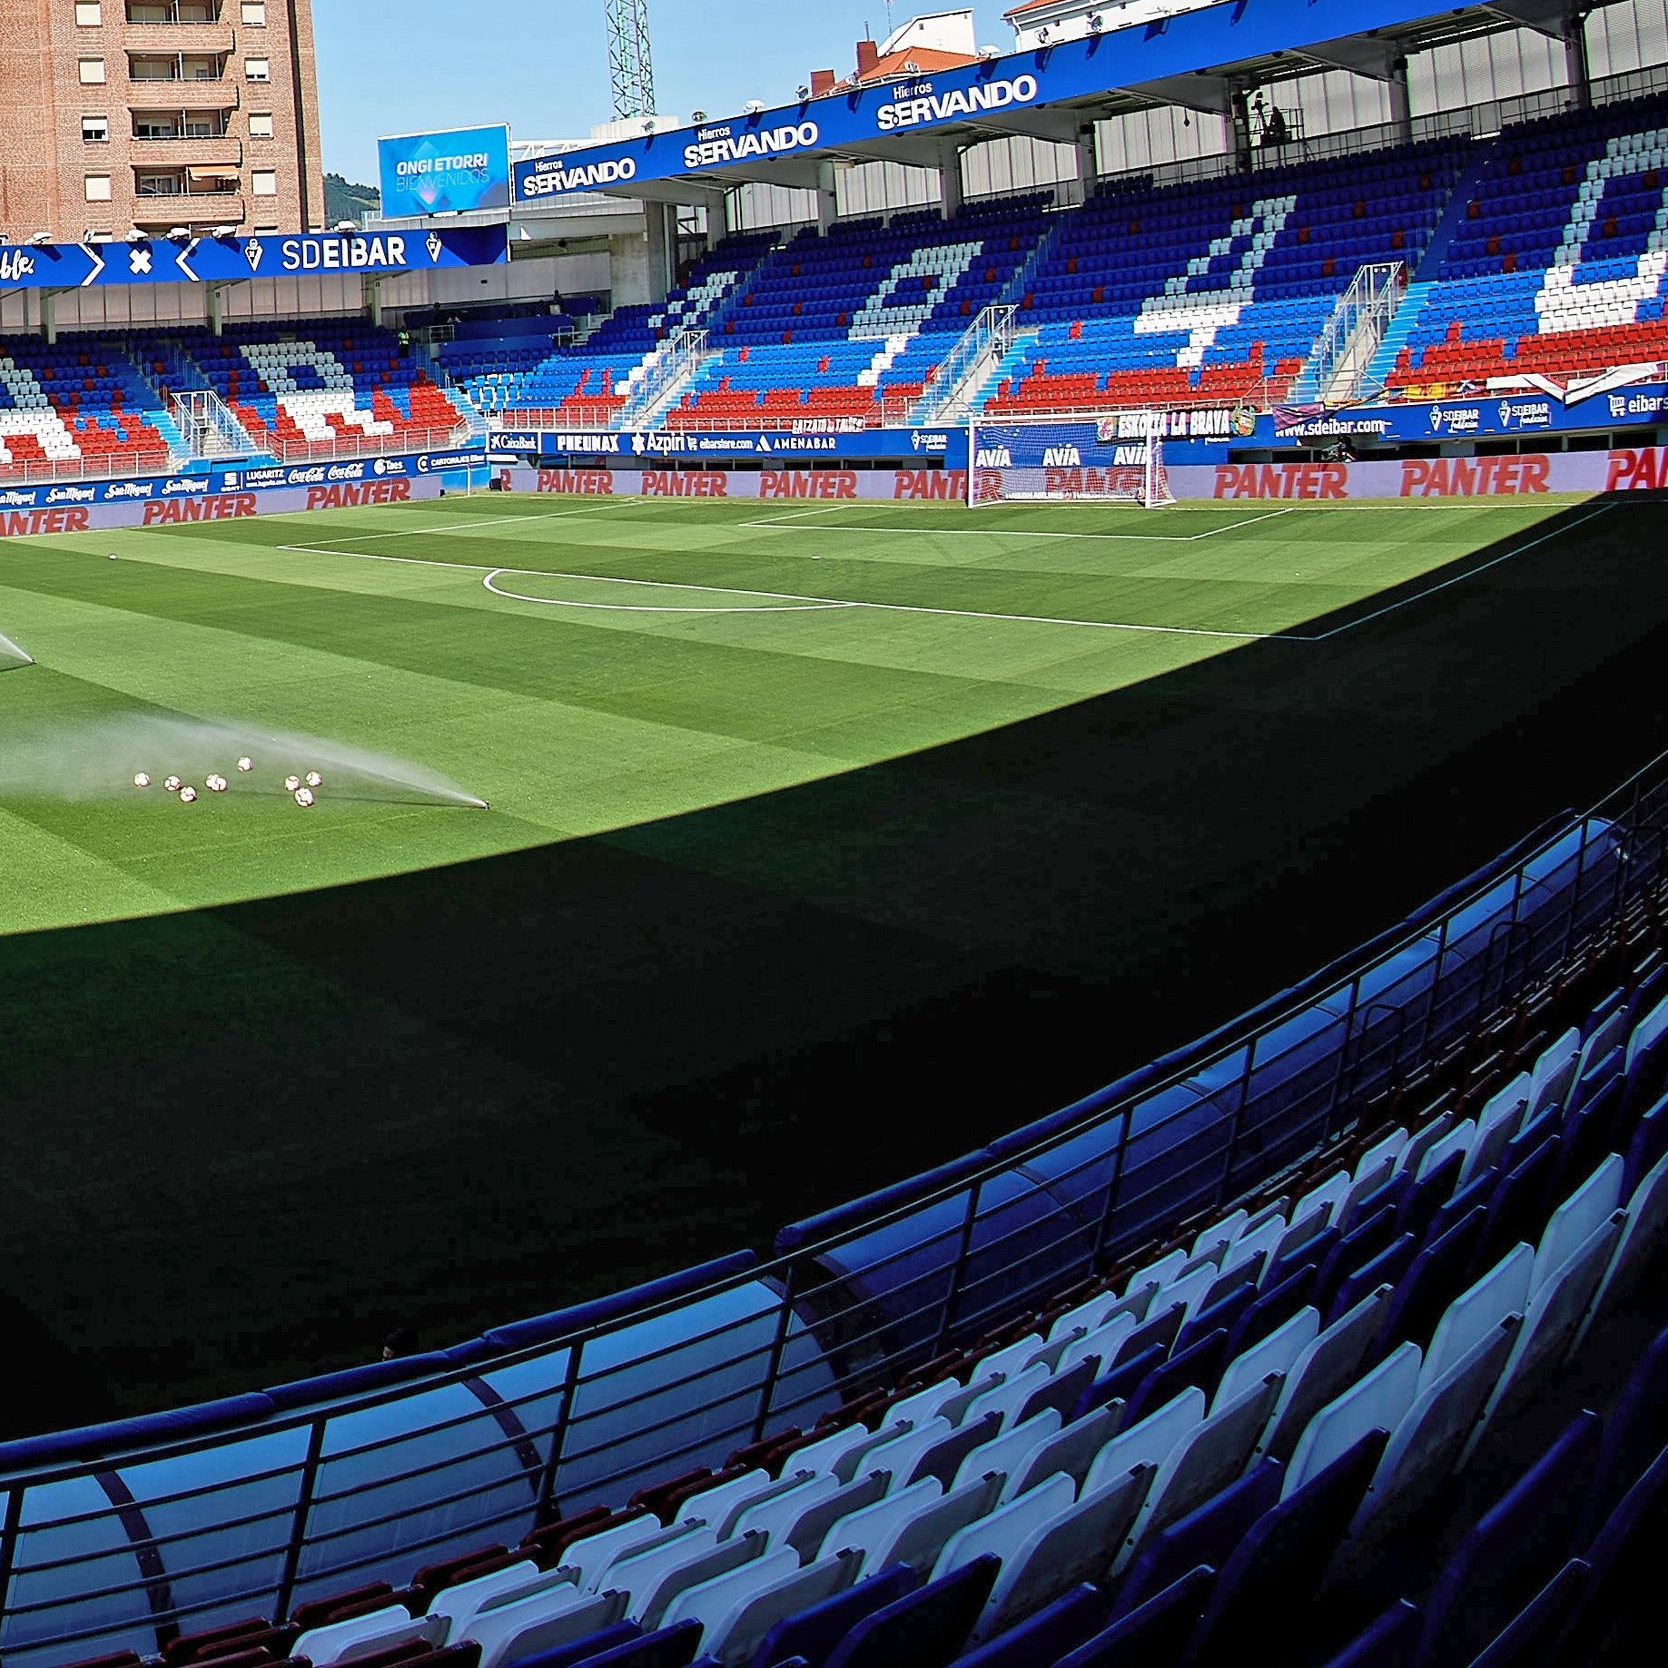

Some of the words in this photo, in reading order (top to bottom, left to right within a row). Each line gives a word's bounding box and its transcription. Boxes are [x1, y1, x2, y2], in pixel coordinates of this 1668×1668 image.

[877, 75, 1037, 130] SERVANDO
[893, 81, 933, 101] Hierros
[683, 121, 819, 168] SERVANDO
[697, 125, 731, 142] Hierros
[396, 158, 433, 176] ONGI
[434, 153, 489, 172] ETORRI
[522, 157, 636, 197] SERVANDO
[534, 160, 563, 173] Hierros
[1171, 411, 1187, 435] LA
[1190, 409, 1230, 436] BRAVA
[773, 437, 837, 450] AMENABAR
[537, 469, 613, 494] PANTER
[641, 470, 728, 497] PANTER
[759, 471, 857, 498] PANTER
[1213, 462, 1349, 499] PANTER
[1400, 454, 1551, 497] PANTER
[306, 478, 411, 510] PANTER
[142, 492, 257, 525] PANTER
